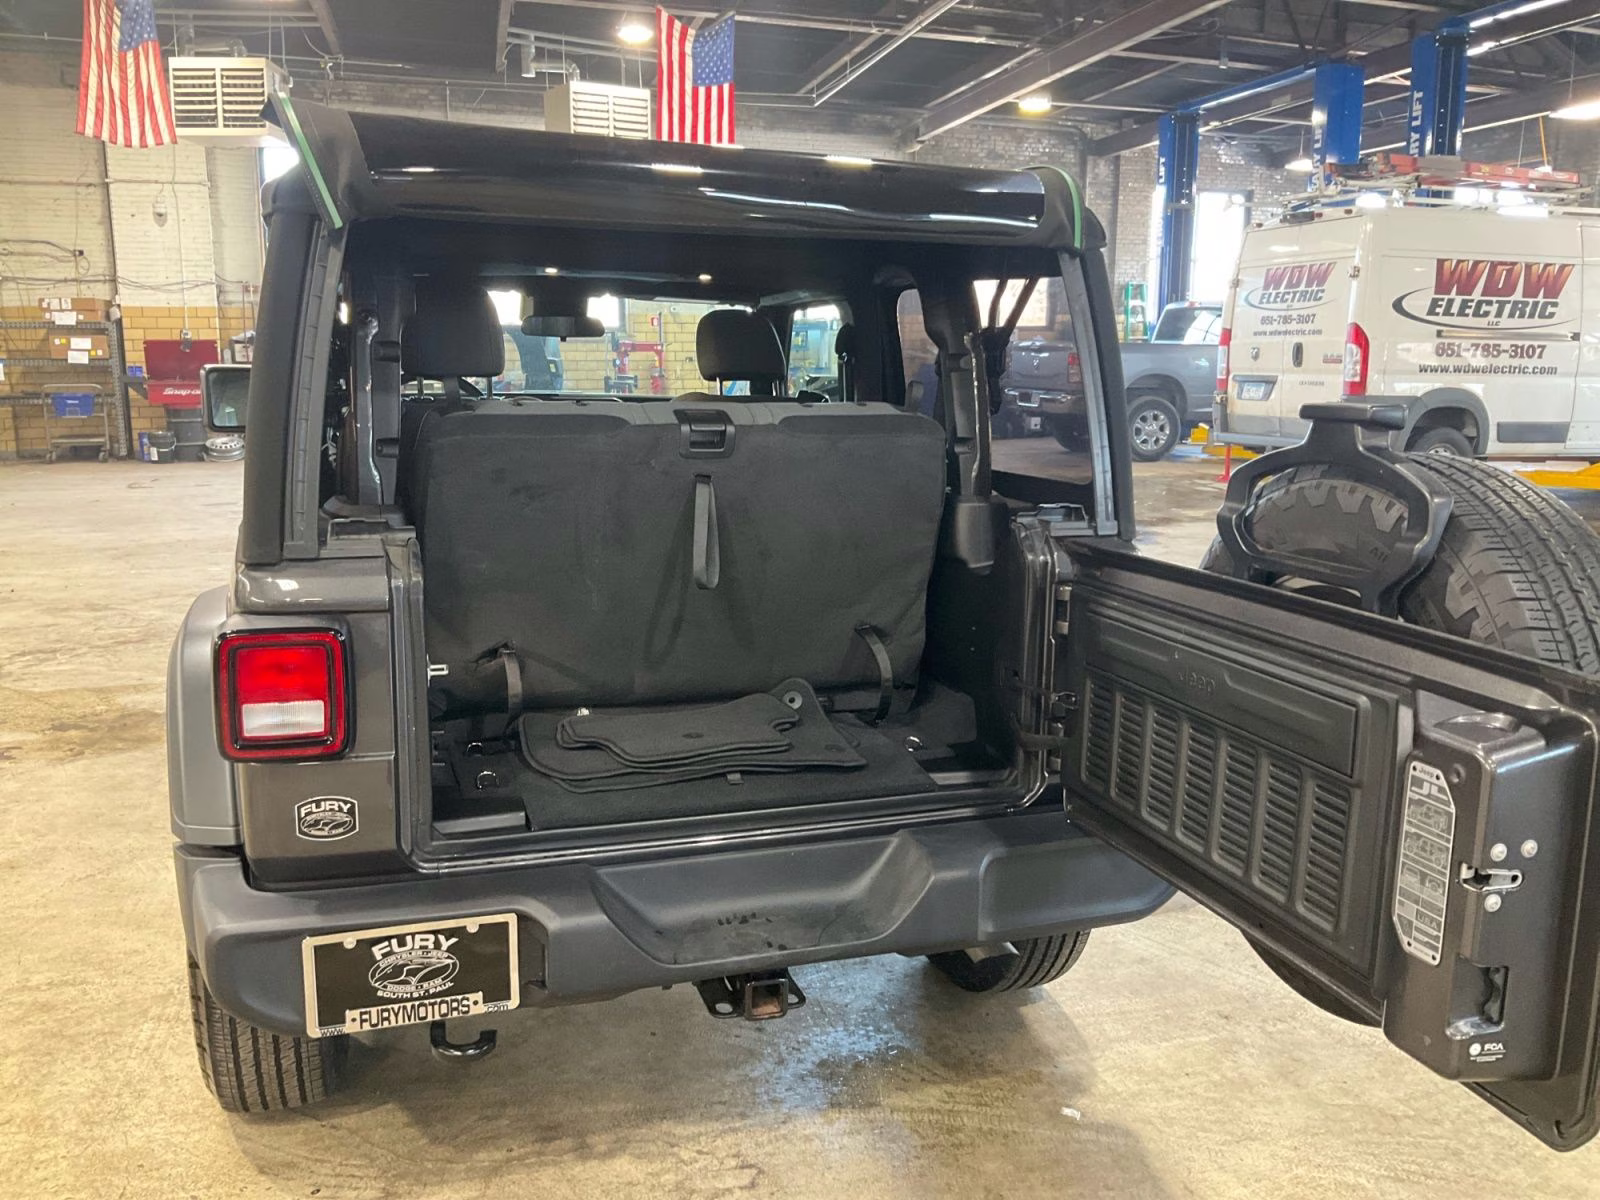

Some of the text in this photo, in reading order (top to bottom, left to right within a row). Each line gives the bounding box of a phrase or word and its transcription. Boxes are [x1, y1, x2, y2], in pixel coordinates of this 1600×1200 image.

[1411, 90, 1424, 127] LIFT
[1262, 261, 1337, 291] WDW
[1434, 258, 1575, 299] WDW
[1258, 288, 1326, 305] ELECTRIC
[1426, 298, 1559, 320] ELECTRIC
[1260, 313, 1317, 326] 651-785-3107
[1434, 341, 1547, 360] 651-785-3107
[1418, 363, 1558, 376] www.wdwelectric.com
[300, 800, 352, 818] FURY
[371, 933, 460, 961] FURY
[376, 981, 455, 999] SOUTH ST. PAUL
[358, 995, 471, 1030] FURYMOTORS
[1483, 1042, 1504, 1051] FCA
